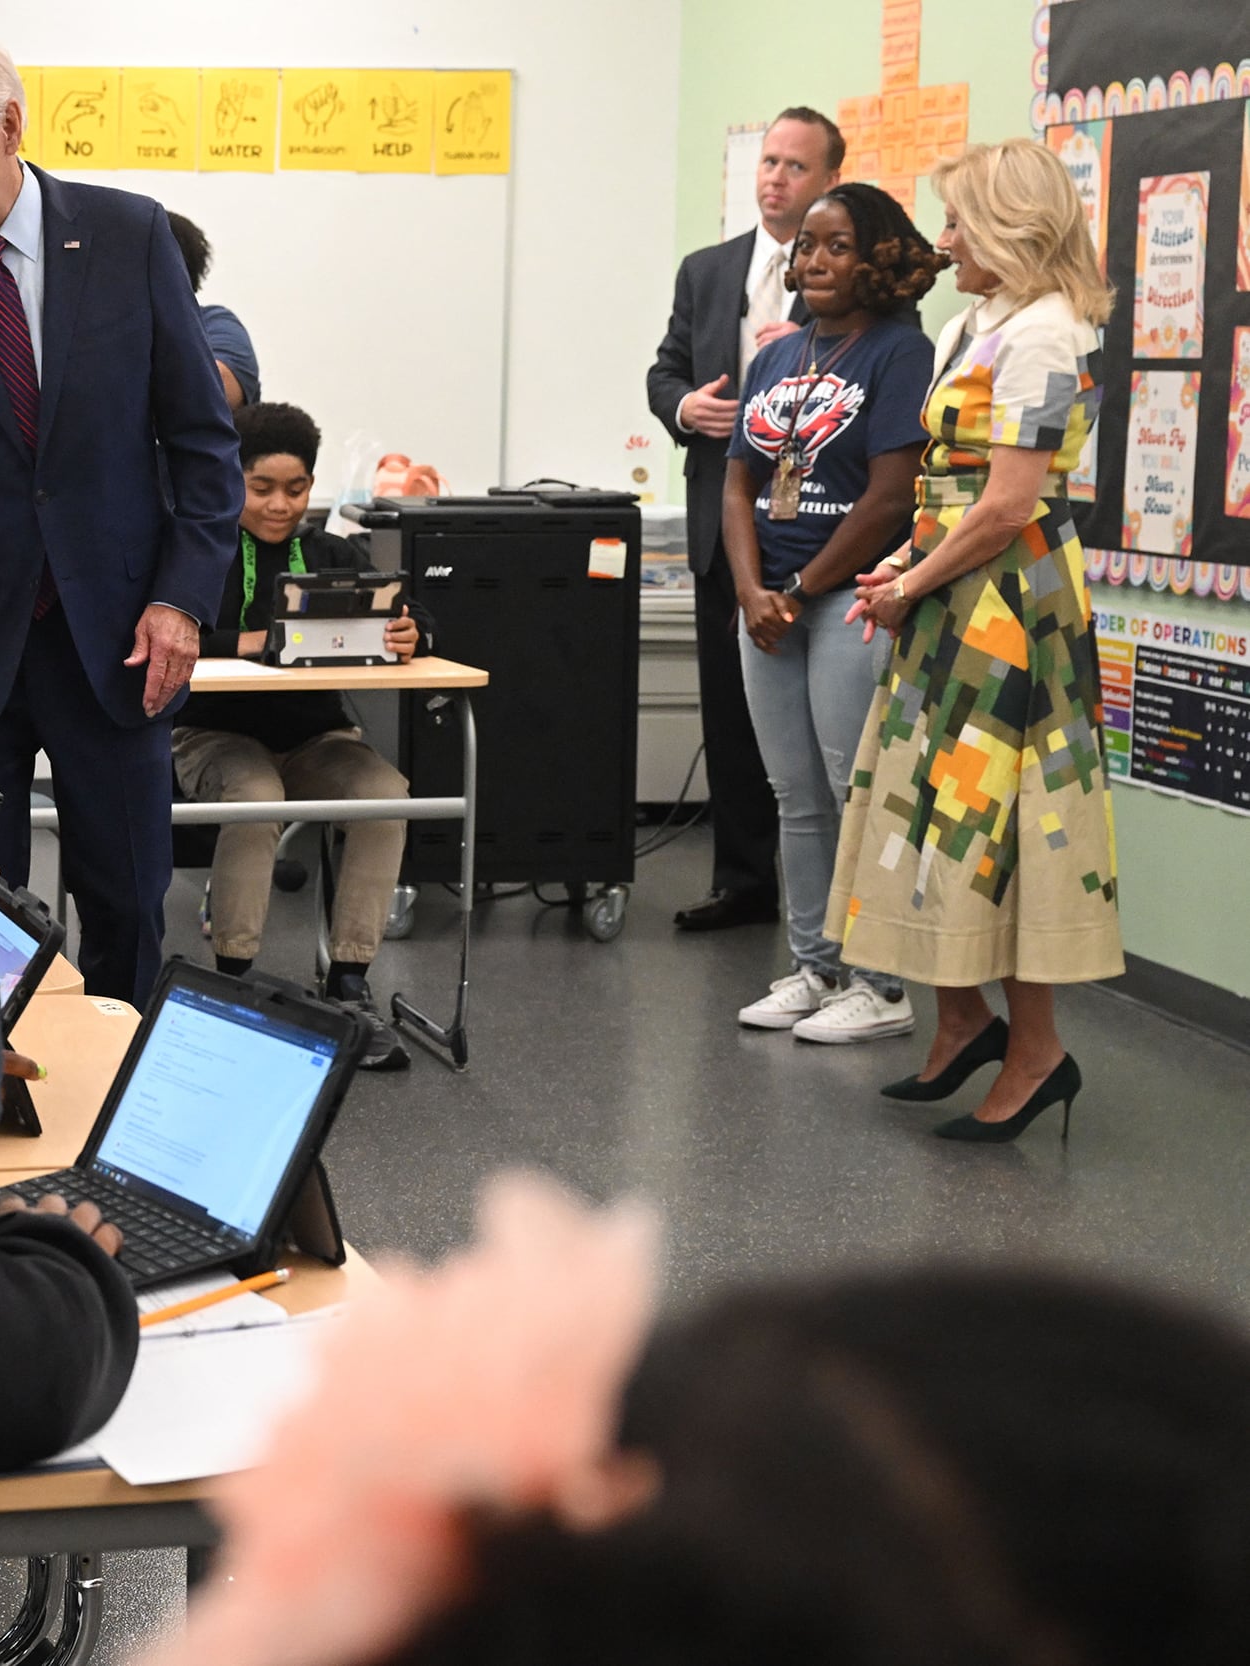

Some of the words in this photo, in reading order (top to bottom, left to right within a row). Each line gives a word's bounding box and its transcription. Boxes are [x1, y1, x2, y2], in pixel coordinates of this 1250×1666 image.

[64, 141, 93, 157] NO
[136, 146, 179, 159] TISSUE
[209, 145, 263, 159] WATER
[372, 142, 413, 158] HELP
[1162, 209, 1185, 225] YOUR
[1151, 226, 1194, 247] Attitude
[1150, 252, 1193, 266] determines
[1158, 271, 1182, 288] YOUR
[1148, 286, 1195, 308] Direction
[1137, 427, 1167, 445] Never
[1144, 475, 1175, 493] Never
[1091, 611, 1126, 633] RDER
[1130, 617, 1149, 637] OF
[1153, 620, 1248, 657] OPERATIONS
